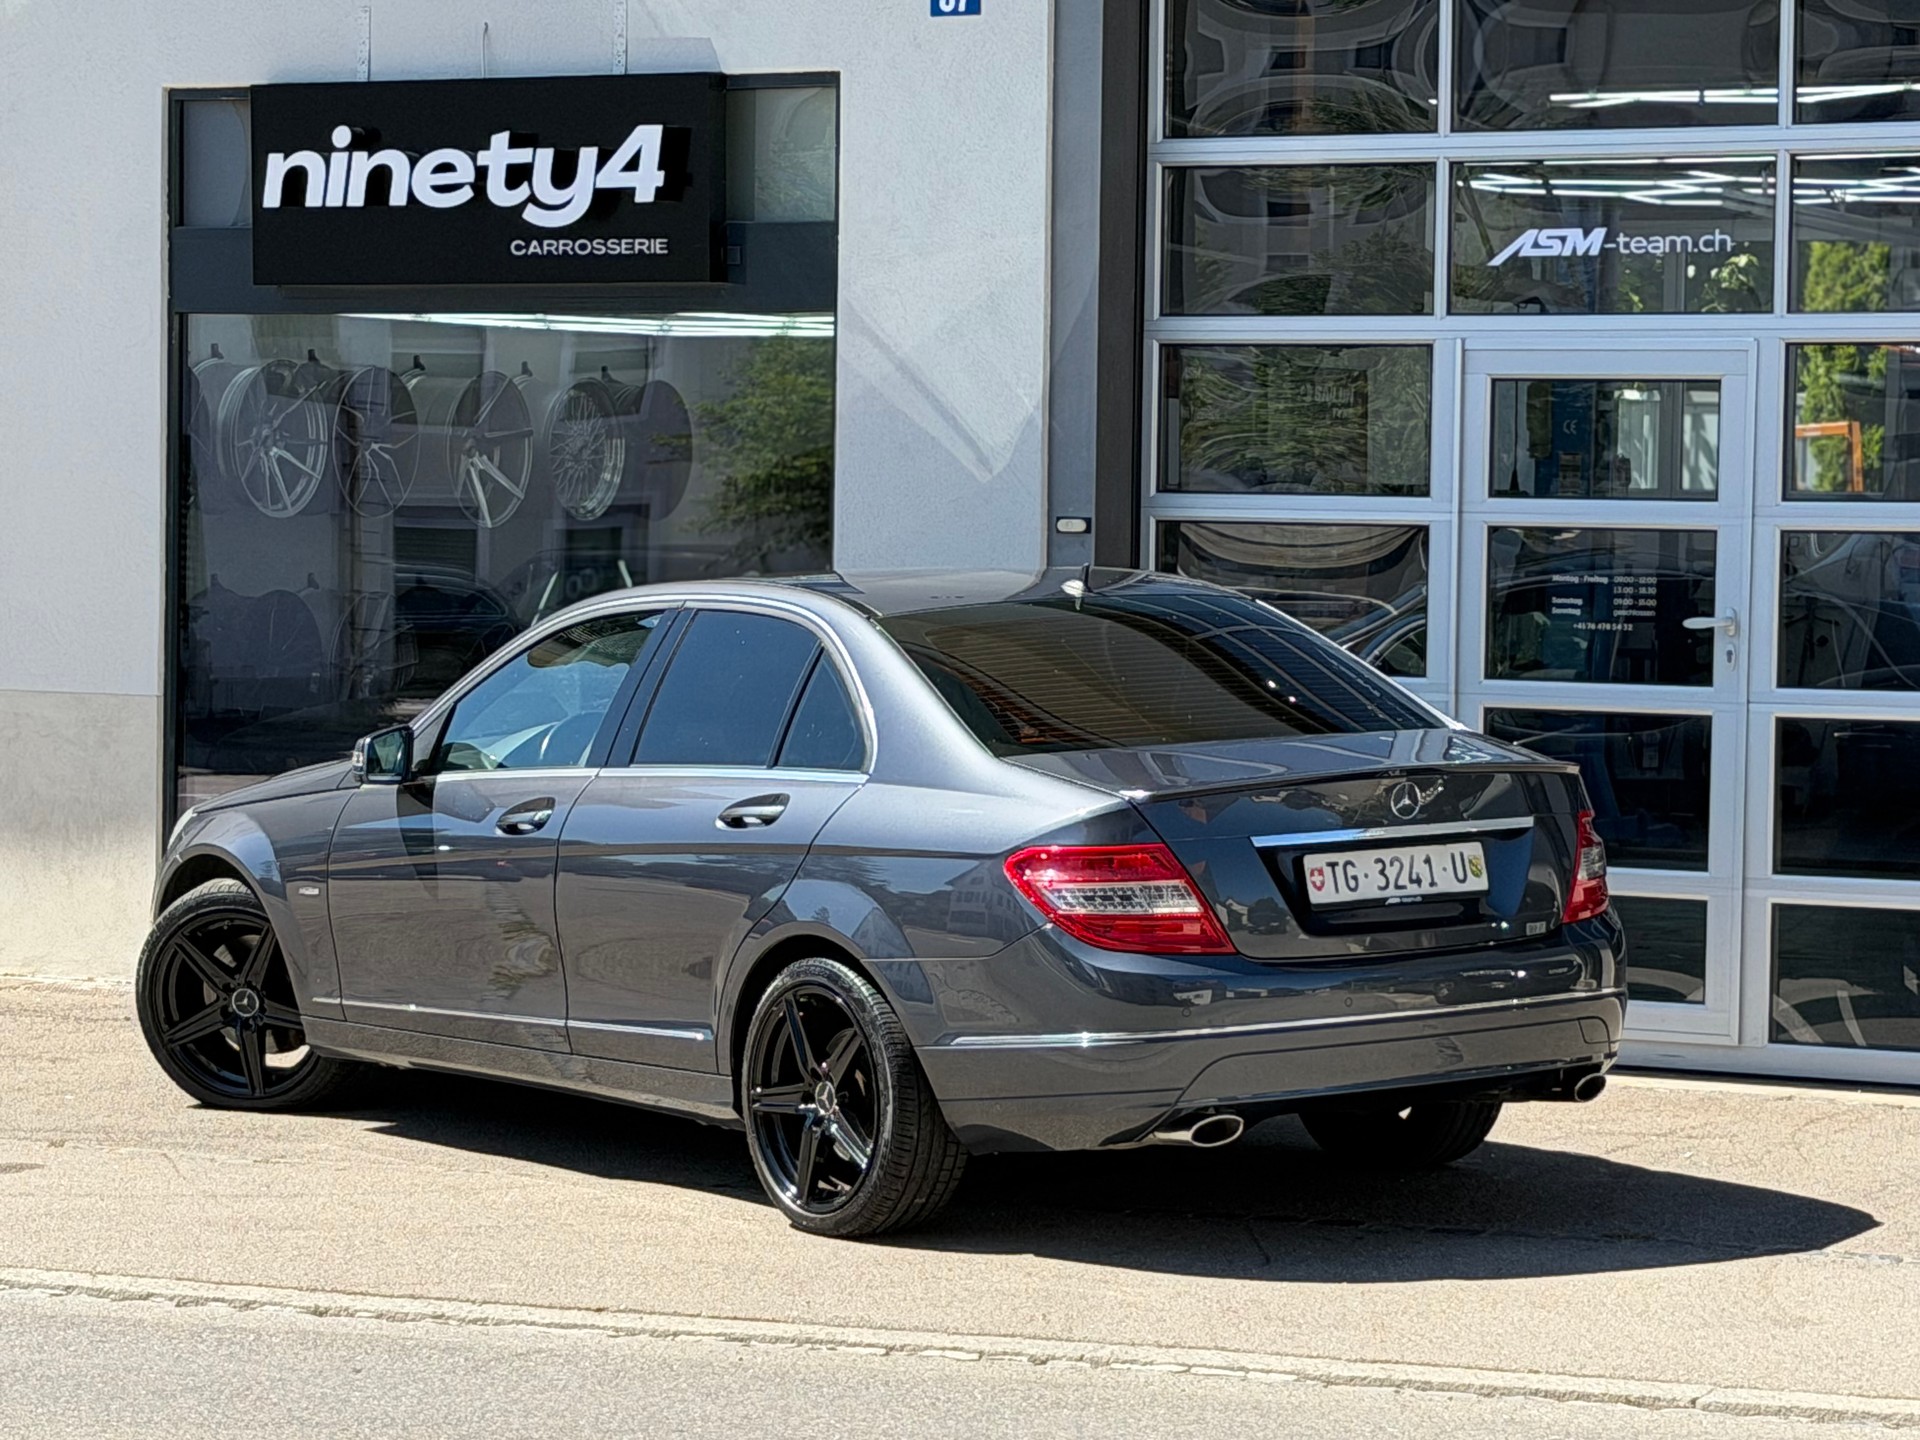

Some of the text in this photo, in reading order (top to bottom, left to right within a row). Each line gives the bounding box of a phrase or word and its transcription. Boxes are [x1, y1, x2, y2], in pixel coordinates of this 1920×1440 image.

[262, 124, 665, 227] ninety4
[510, 238, 669, 256] CARROSSERIE
[1487, 227, 1732, 267] ASM-team.ch
